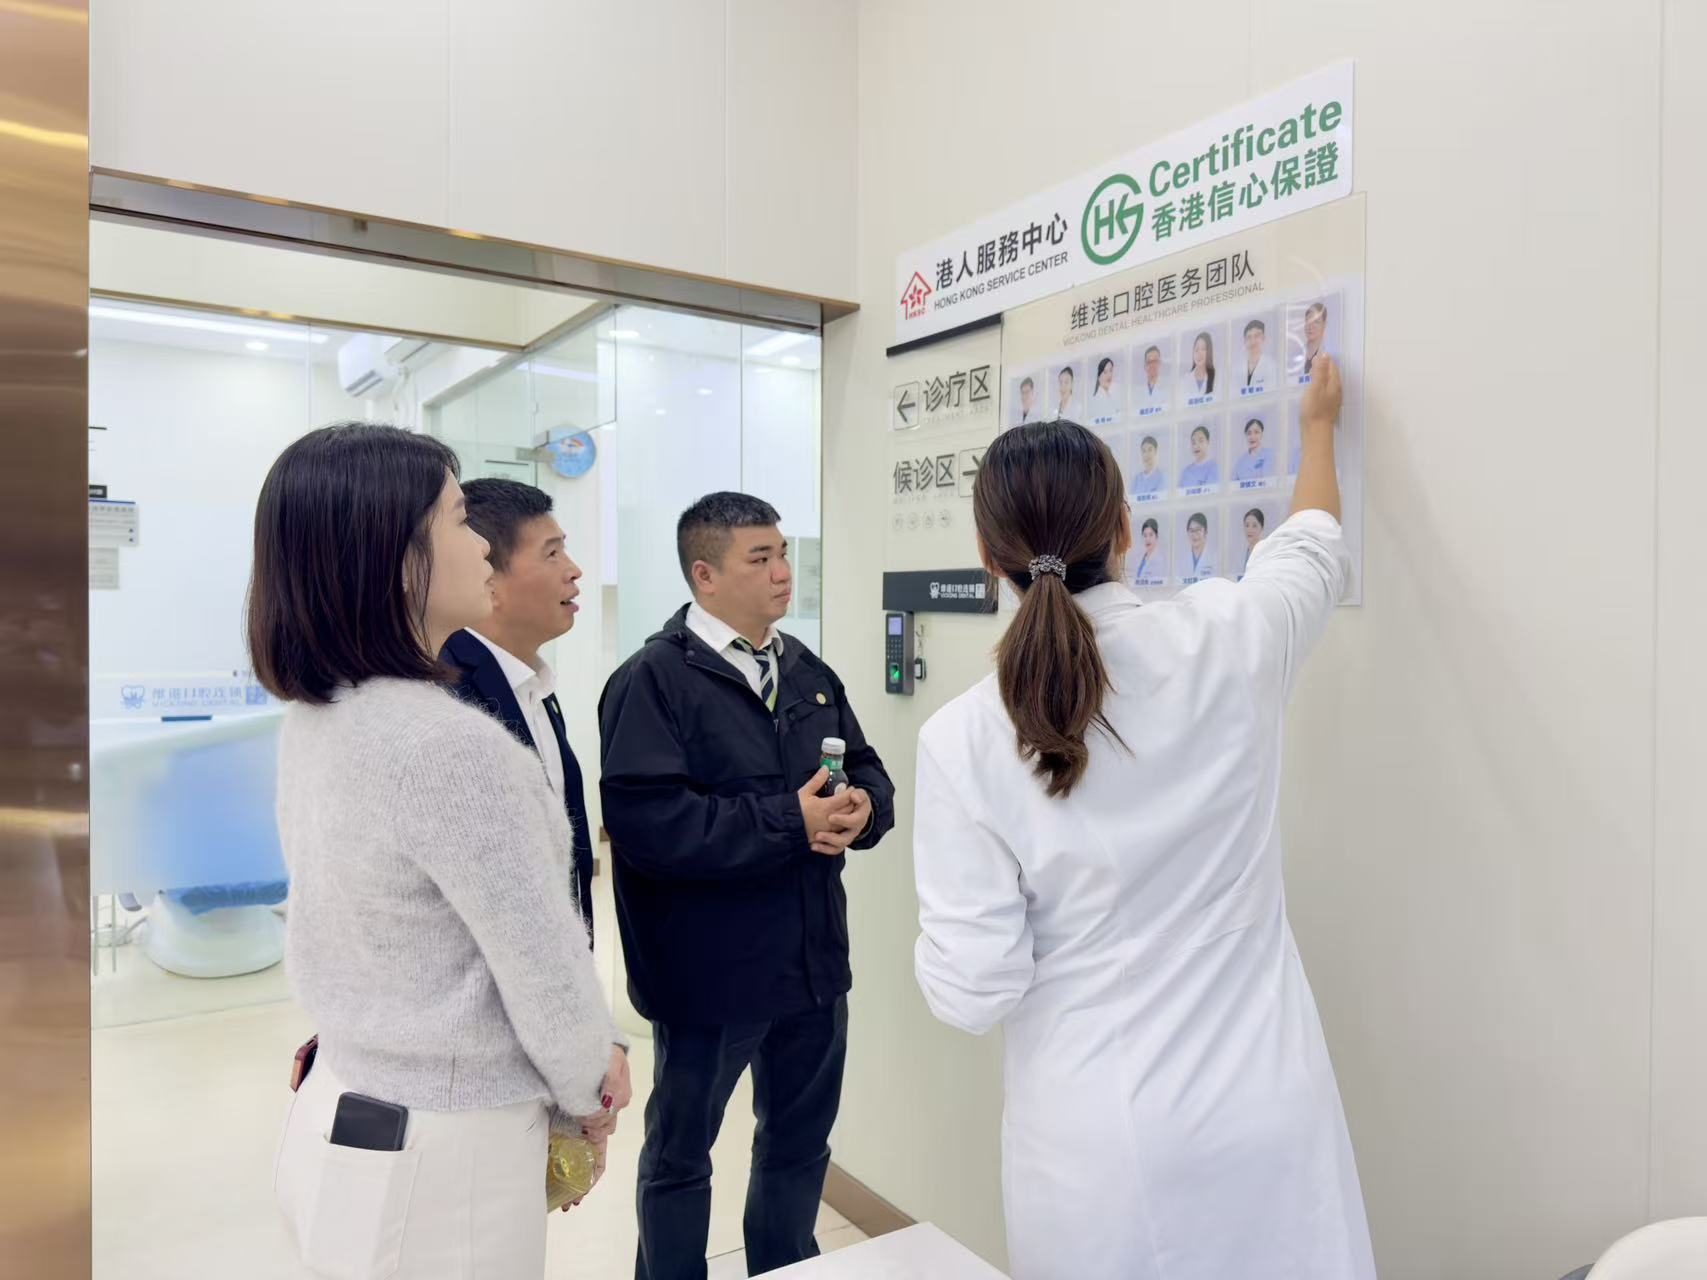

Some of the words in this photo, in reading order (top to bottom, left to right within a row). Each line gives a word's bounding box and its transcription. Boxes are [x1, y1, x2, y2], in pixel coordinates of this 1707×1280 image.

[1149, 101, 1342, 197] Certificate
[1151, 141, 1339, 242] 香港信心保證
[934, 293, 959, 311] HONG
[959, 283, 985, 301] KONG
[986, 268, 1026, 292] SERVICE
[1028, 251, 1069, 276] CENTER
[935, 212, 1068, 291] 港人服務中心
[1063, 330, 1097, 346] VICKONG
[1099, 321, 1129, 336] DENTAL
[1131, 304, 1189, 327] HEALTHCARE
[1190, 282, 1265, 311] PROFESSIONAL
[1071, 250, 1255, 330] 维港口腔医务团队
[923, 365, 990, 412] 诊疗区
[893, 454, 955, 494] 候诊区
